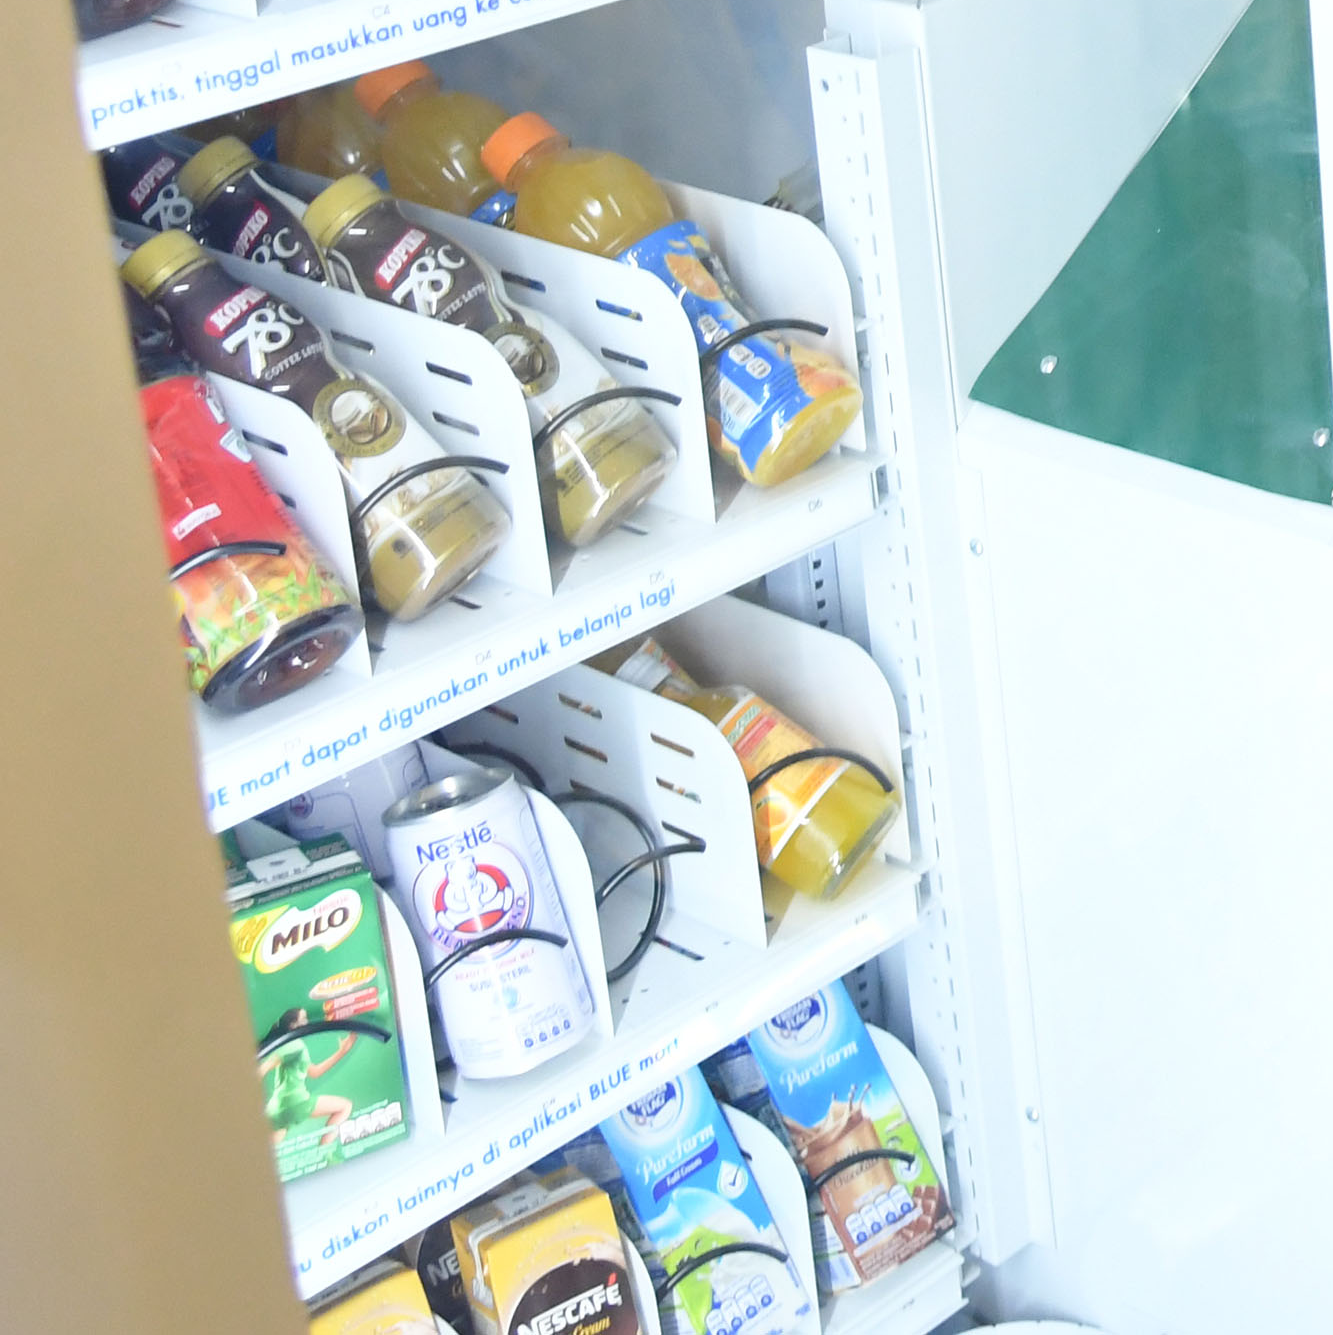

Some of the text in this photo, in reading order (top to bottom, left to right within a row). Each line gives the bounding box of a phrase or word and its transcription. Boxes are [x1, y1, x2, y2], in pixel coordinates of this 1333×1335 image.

[195, 49, 281, 93] tinggal
[291, 22, 404, 66] masukkan
[413, 2, 468, 27] uang
[239, 757, 291, 799] mart
[301, 726, 368, 771] dapat
[379, 668, 489, 731] digunakan
[497, 637, 551, 677] untuk
[559, 604, 633, 650] belanja
[640, 579, 677, 613] lagi
[416, 821, 493, 865] Nestlé
[271, 907, 350, 955] MILO
[322, 1211, 390, 1262] diskon
[397, 1163, 475, 1213] lainnya
[483, 1140, 501, 1167] di
[509, 1097, 583, 1152] aplikasi
[589, 1063, 632, 1102] BLUE
[639, 1036, 680, 1074] mart
[517, 1273, 622, 1335] NESCAFÉ
